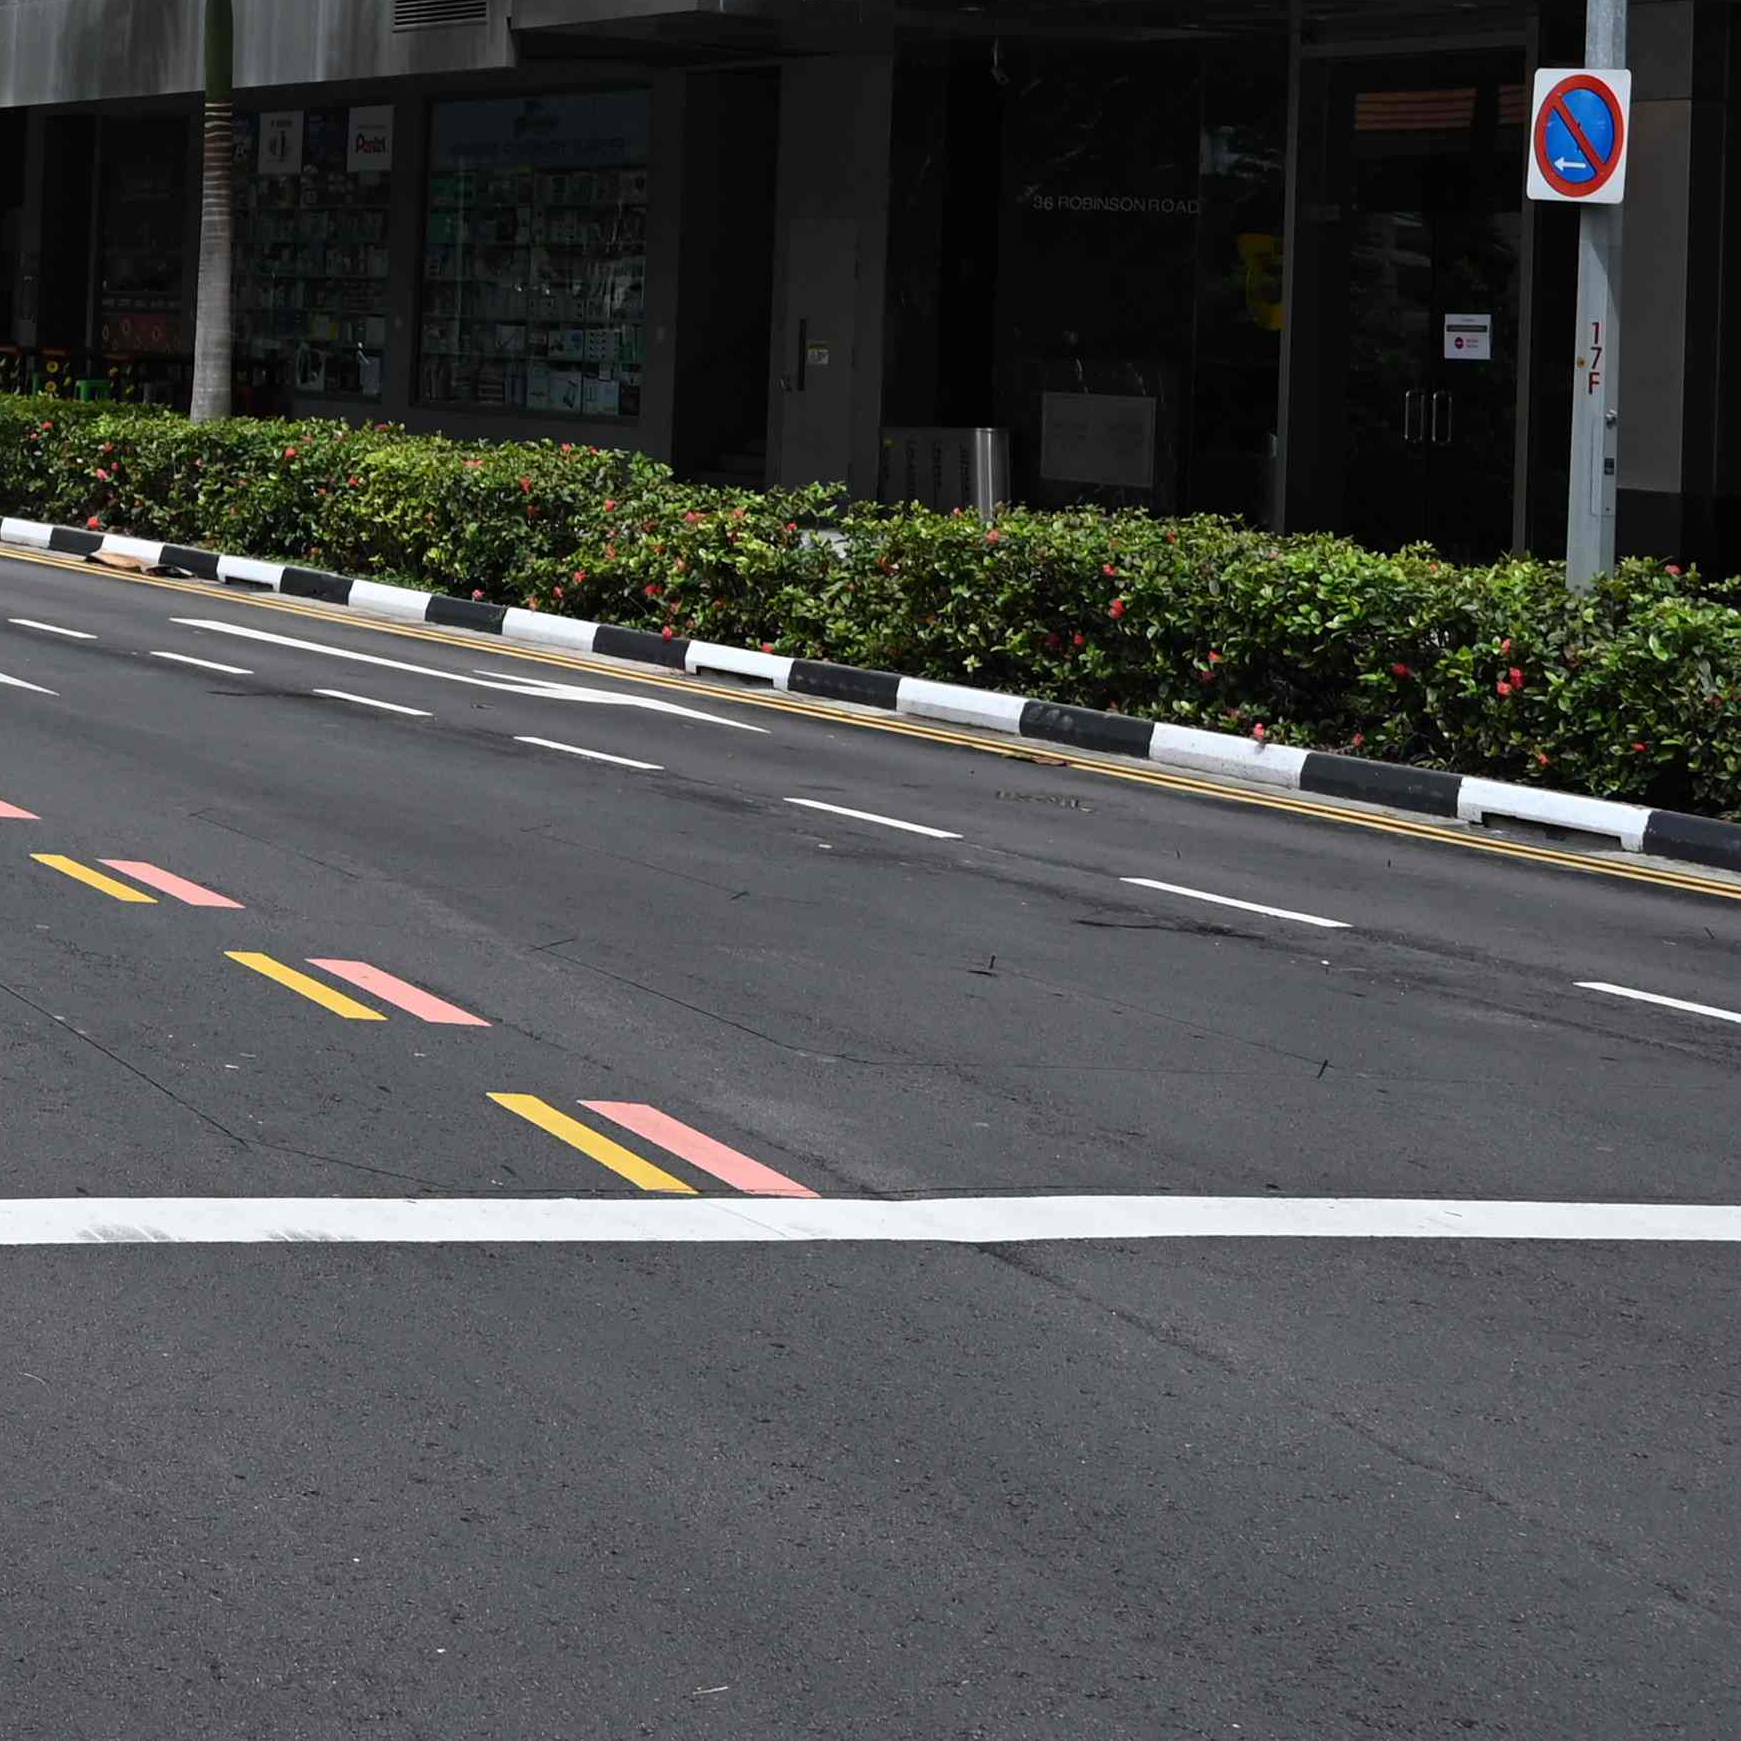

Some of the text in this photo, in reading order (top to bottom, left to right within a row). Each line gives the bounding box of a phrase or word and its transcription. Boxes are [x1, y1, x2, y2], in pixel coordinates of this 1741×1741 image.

[1033, 195, 1199, 215] 36 ROBINSON ROAD
